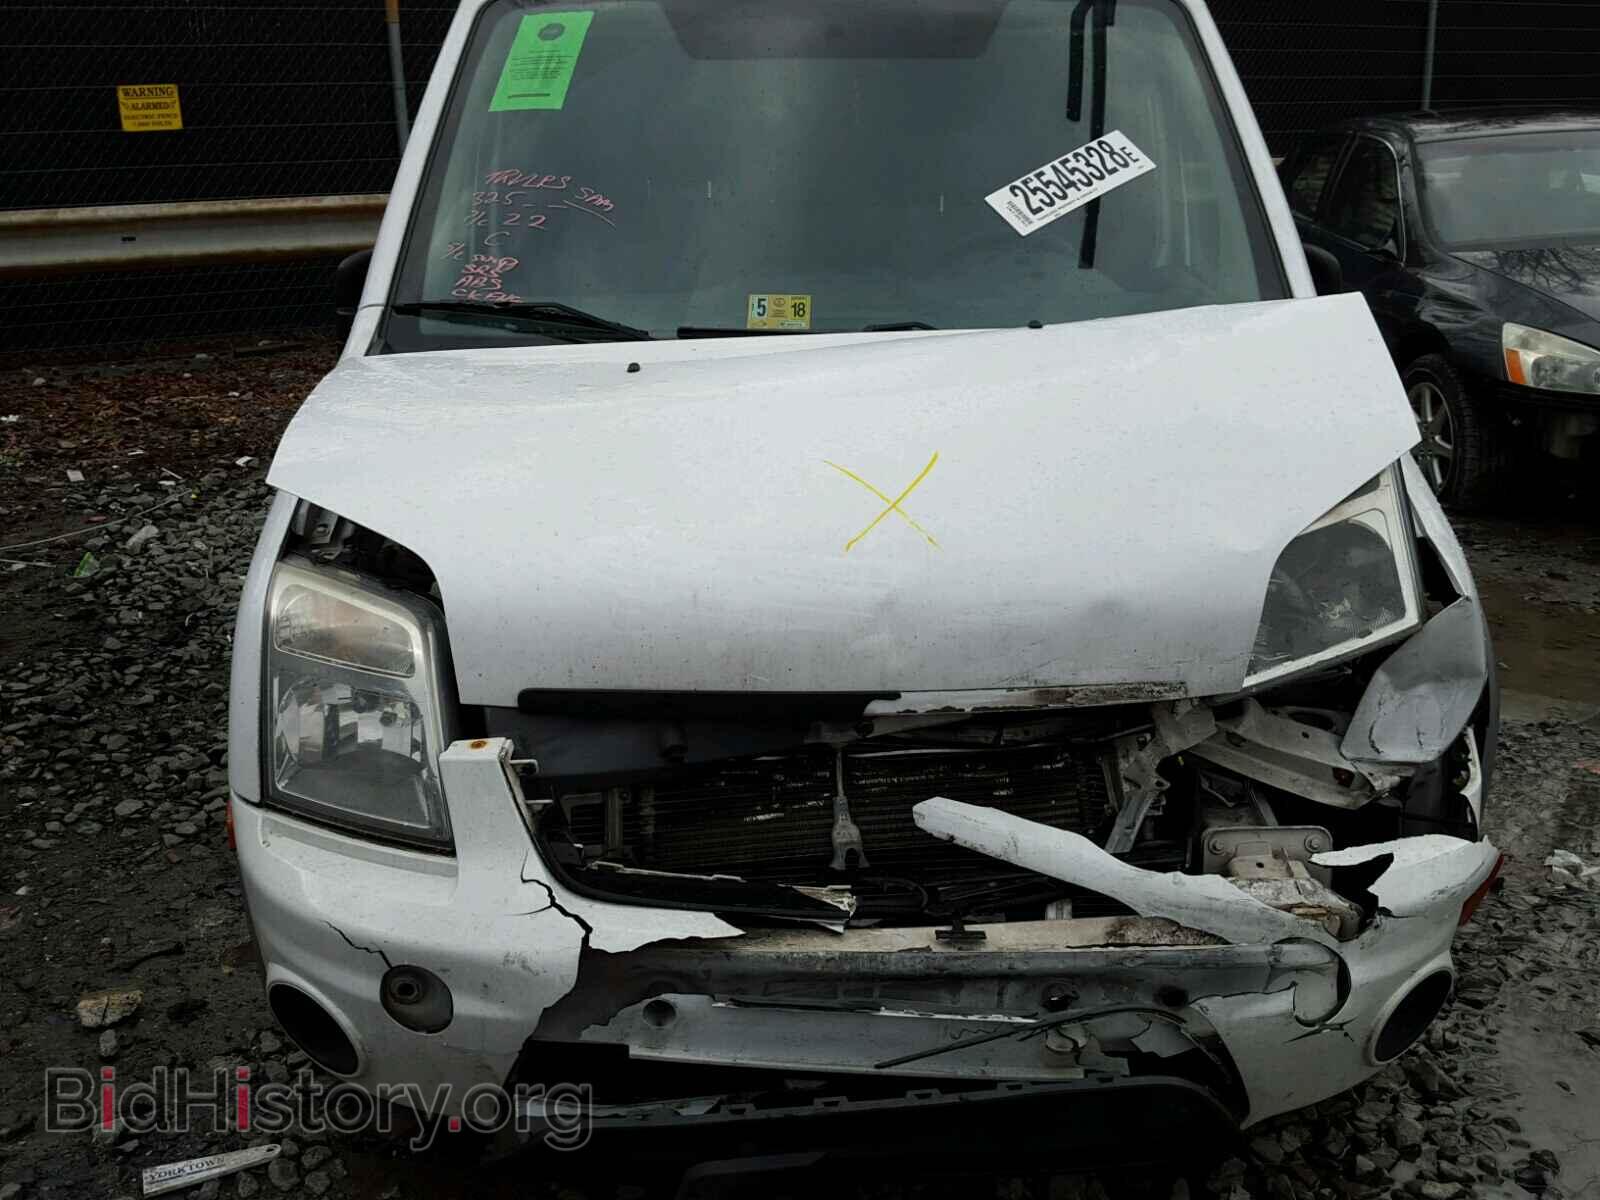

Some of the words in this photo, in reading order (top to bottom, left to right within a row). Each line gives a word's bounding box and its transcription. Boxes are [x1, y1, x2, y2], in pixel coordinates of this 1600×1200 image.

[121, 86, 175, 97] WARNING
[757, 297, 767, 317] 5
[791, 302, 806, 318] 18
[149, 1155, 225, 1181] YORKTOWN
